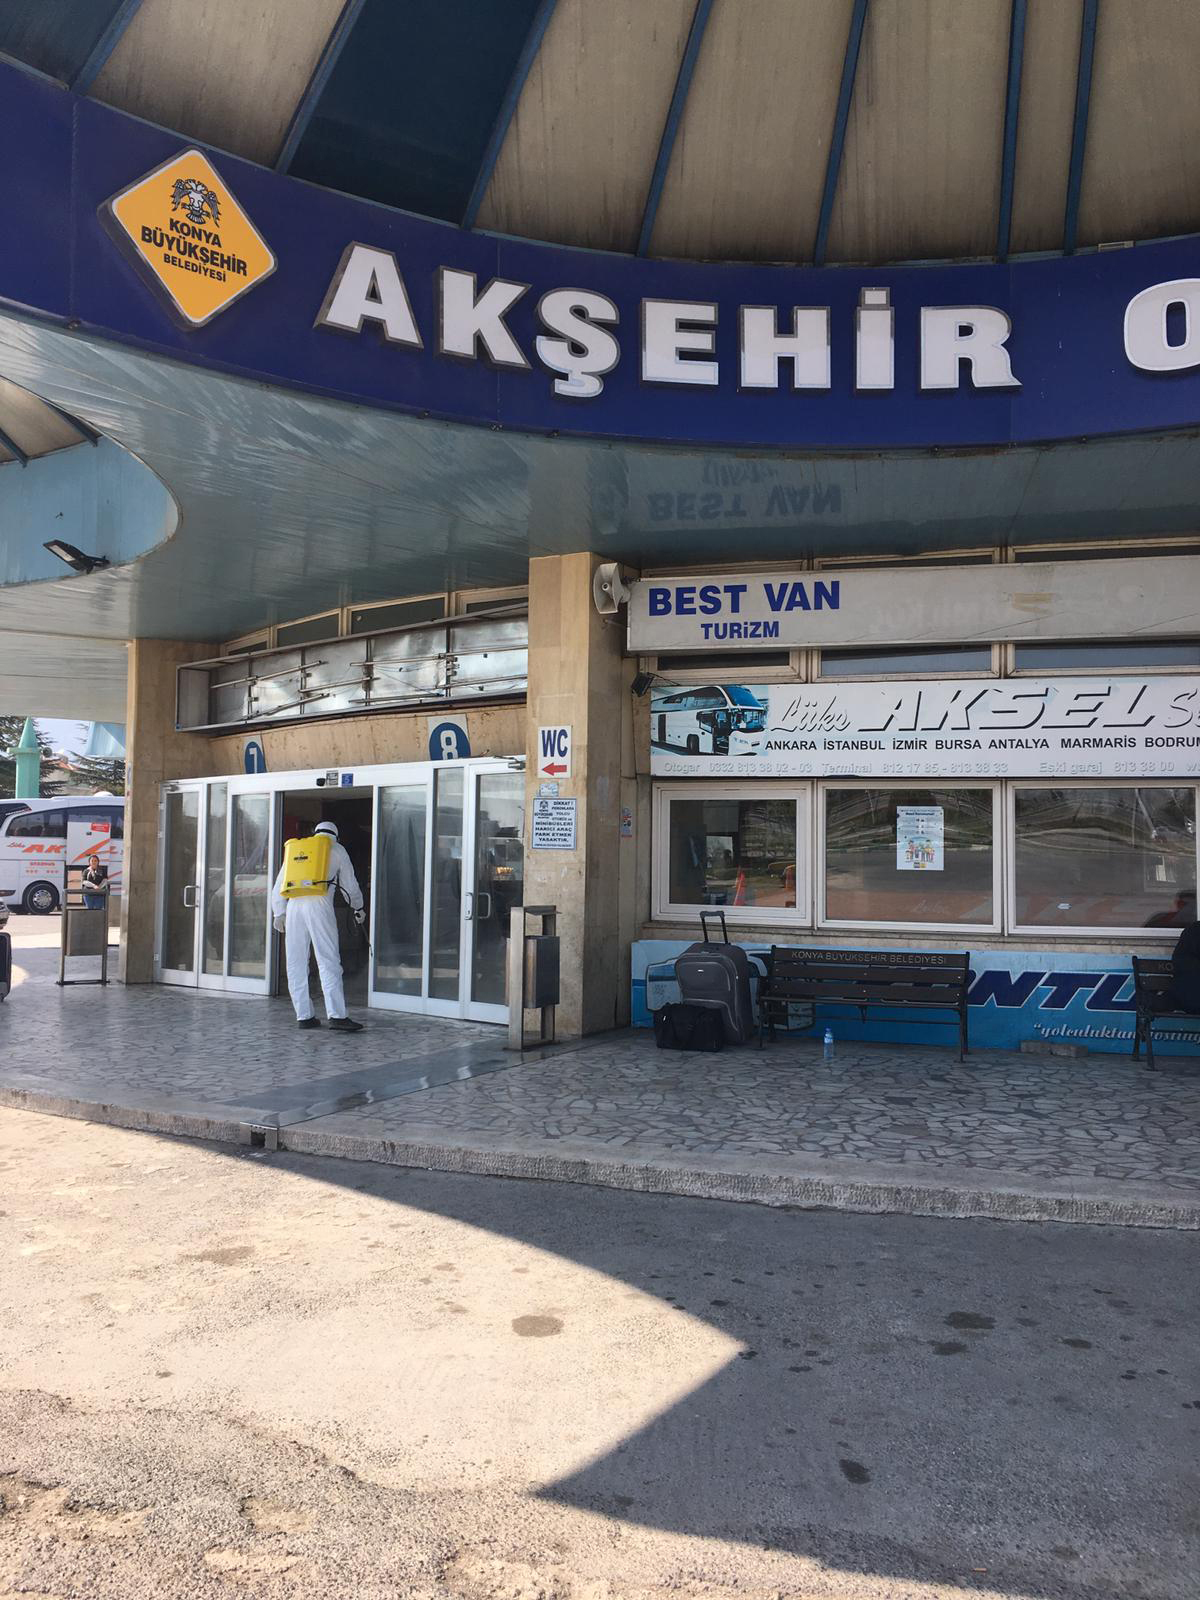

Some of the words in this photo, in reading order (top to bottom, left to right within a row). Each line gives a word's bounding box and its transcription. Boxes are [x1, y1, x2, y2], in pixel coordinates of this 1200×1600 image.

[169, 217, 222, 248] KONYA
[141, 225, 247, 276] BÜYÜKŞEHİR
[163, 253, 226, 282] BELEDİYESİ
[312, 240, 1022, 398] AKŞEHİR
[648, 584, 748, 617] BEST
[763, 580, 841, 612] VAN
[440, 729, 459, 760] 8
[541, 729, 568, 757] WC
[765, 740, 817, 750] ANKARA
[823, 738, 886, 751] İSTANBUL
[892, 737, 928, 750] İZMİR
[935, 739, 982, 750] BURSA
[988, 738, 1050, 749] ANTALYA
[1060, 735, 1137, 749] MARMARİS
[664, 762, 700, 773] Otogar
[822, 762, 872, 774] Terminal
